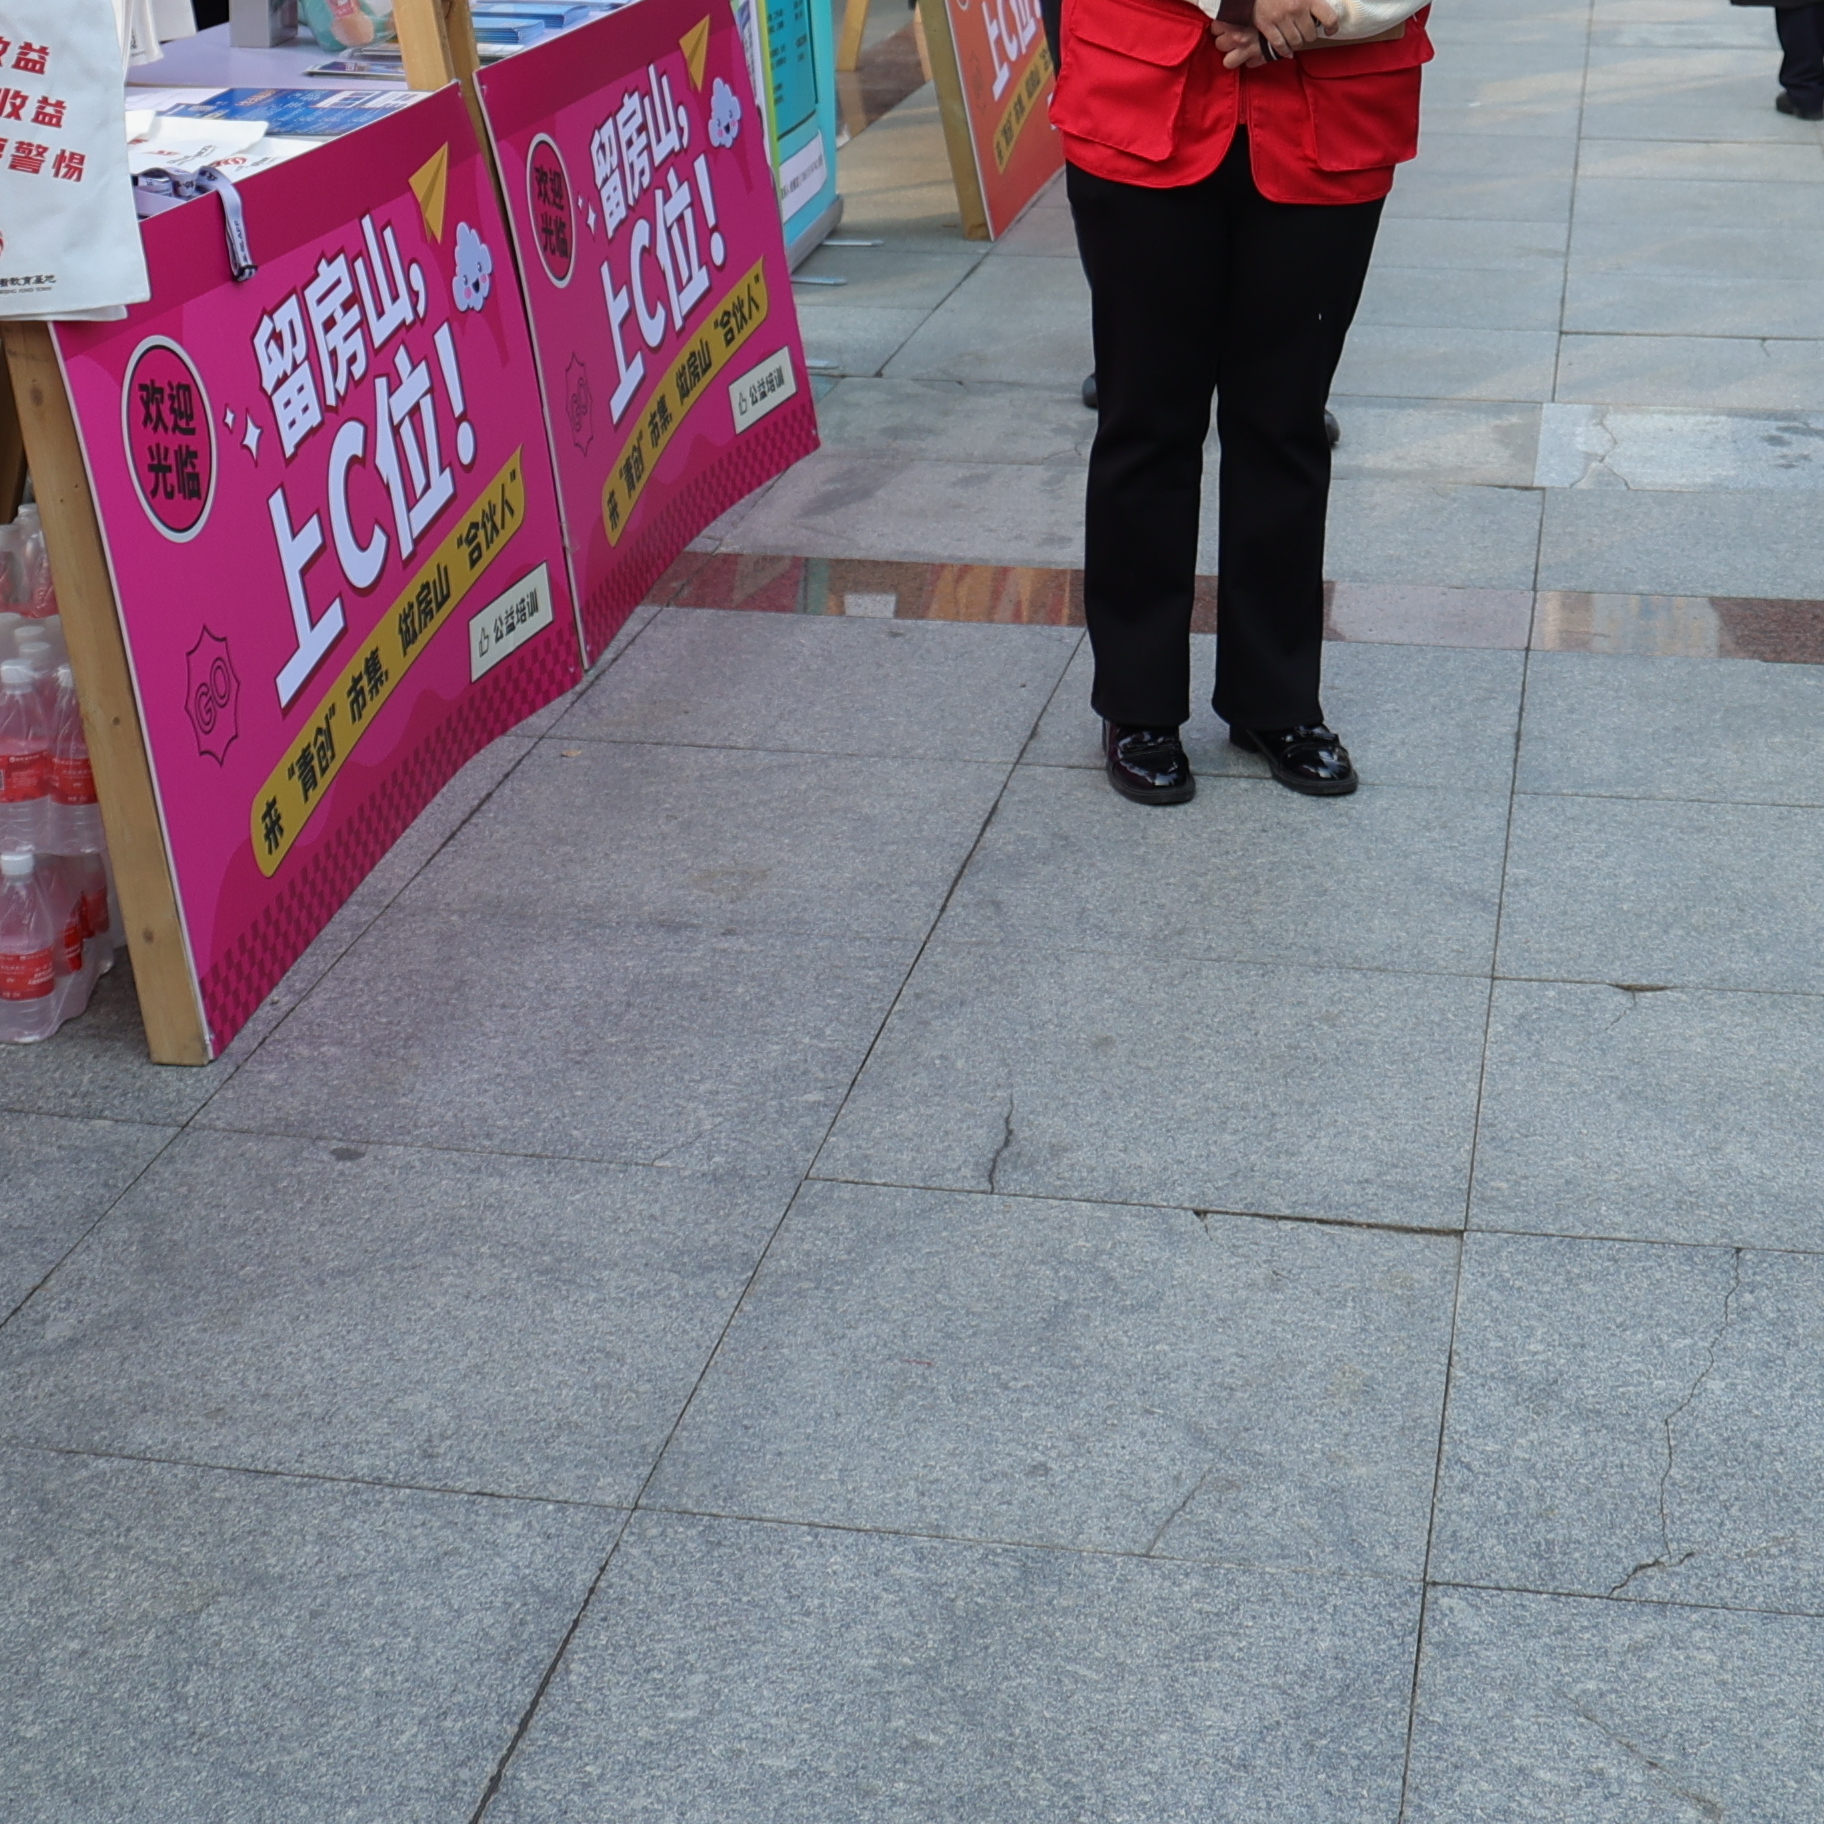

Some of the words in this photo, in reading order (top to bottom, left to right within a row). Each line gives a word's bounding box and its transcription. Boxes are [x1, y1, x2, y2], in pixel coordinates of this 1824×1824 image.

[588, 63, 689, 238] 留房山，
[253, 212, 427, 461] 留房山，
[602, 154, 727, 425] 上C位！
[136, 378, 197, 440] 欢迎
[749, 370, 786, 410] 公益培训
[145, 440, 204, 504] 光临
[266, 320, 477, 711] 上C位！
[492, 591, 540, 644] 公益培训
[193, 654, 233, 736] GO
[261, 797, 284, 857] 来
[398, 560, 453, 661] 做房山
